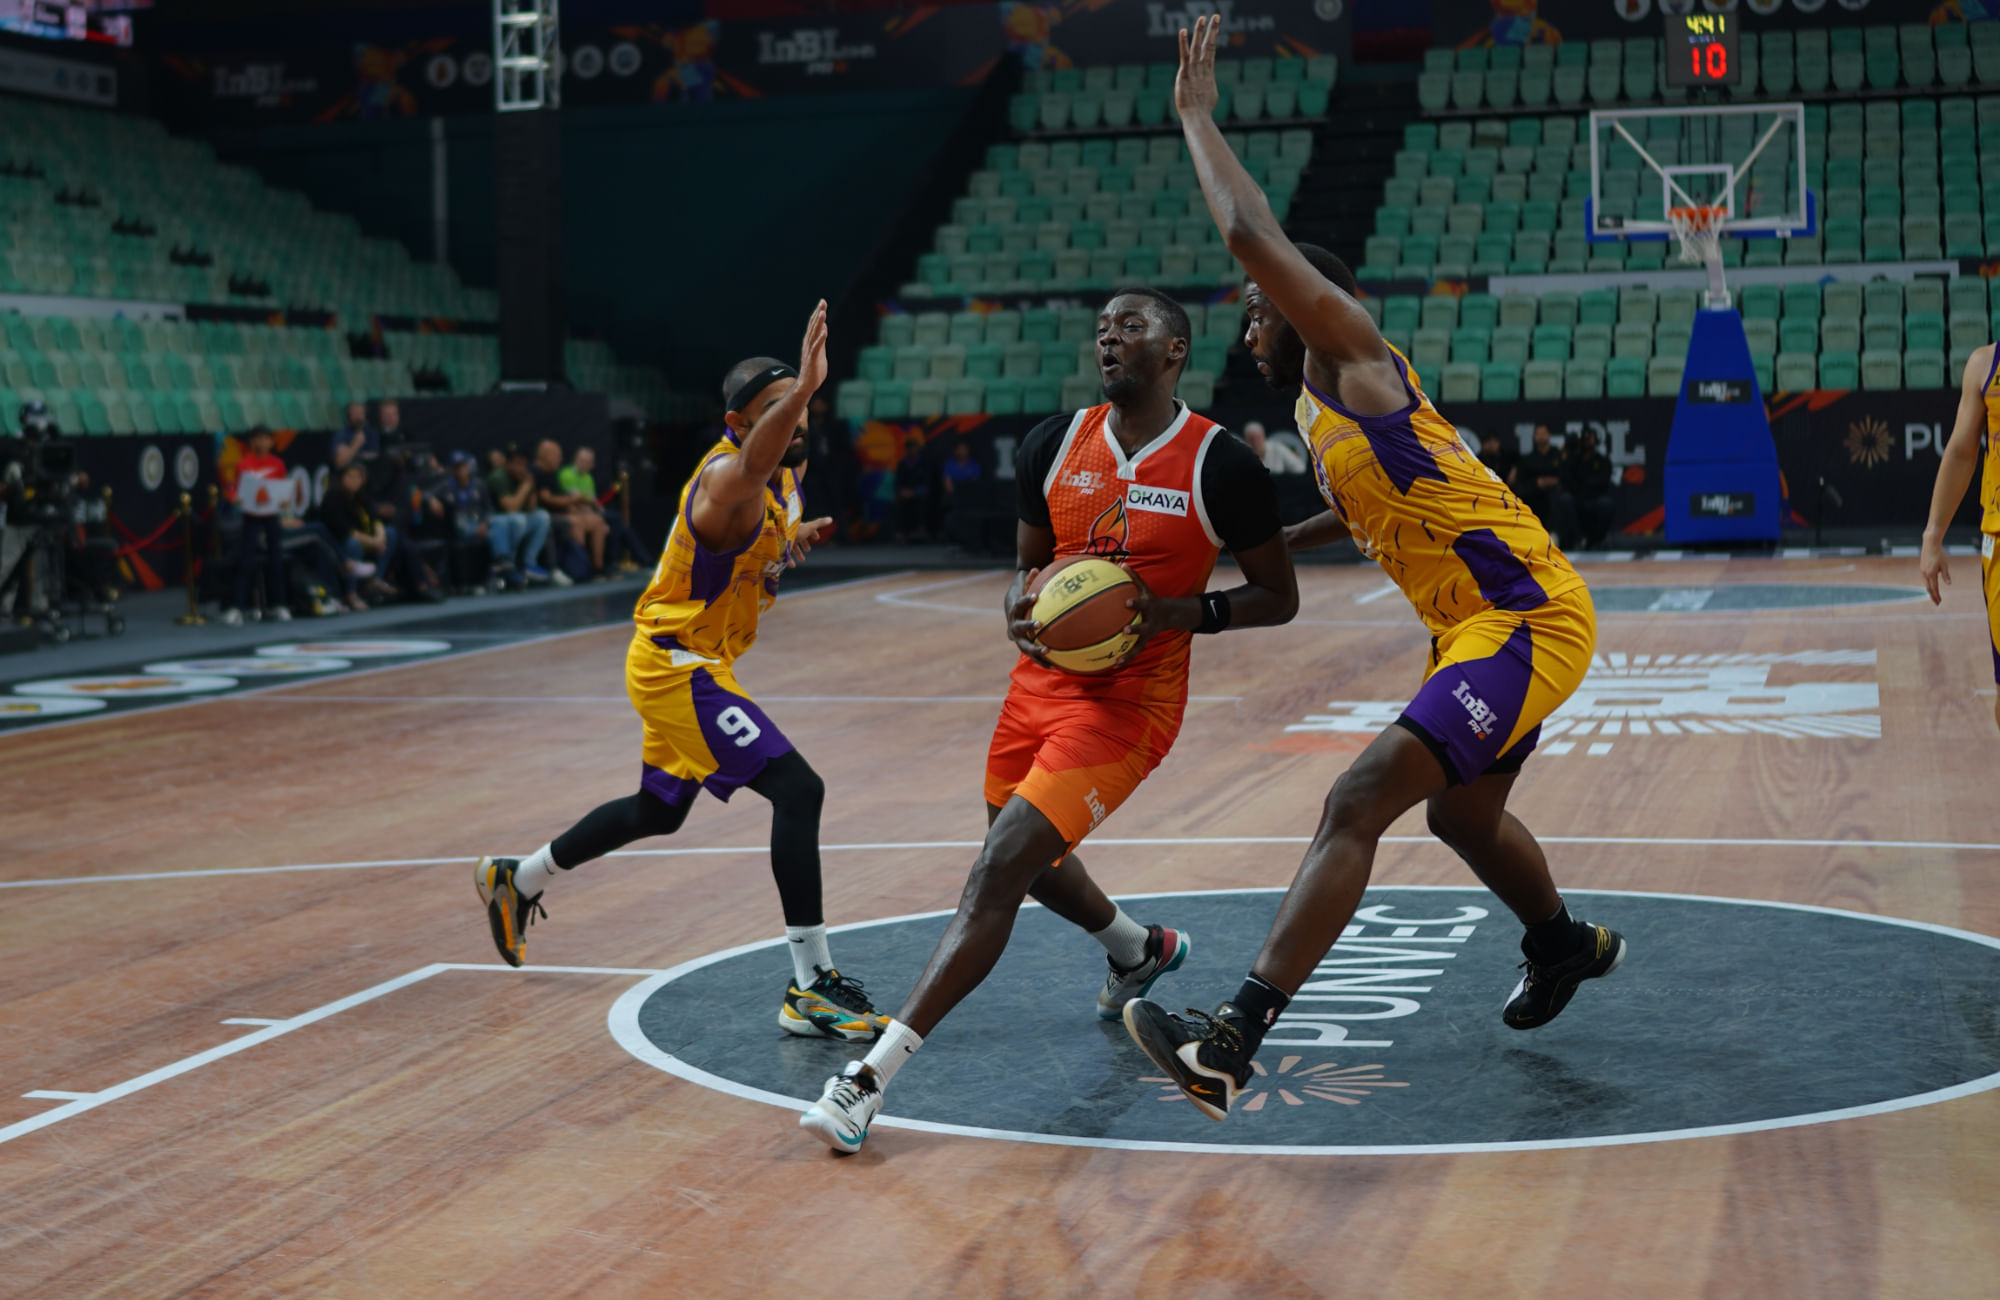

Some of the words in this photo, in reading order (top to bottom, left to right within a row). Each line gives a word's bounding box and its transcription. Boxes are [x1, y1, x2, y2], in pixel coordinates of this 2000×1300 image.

[1686, 14, 1725, 34] 4:41
[1692, 42, 1727, 79] 10
[1059, 469, 1105, 489] InBL
[1128, 489, 1186, 511] OKAYA
[1451, 680, 1498, 735] InBL
[716, 705, 761, 748] 9
